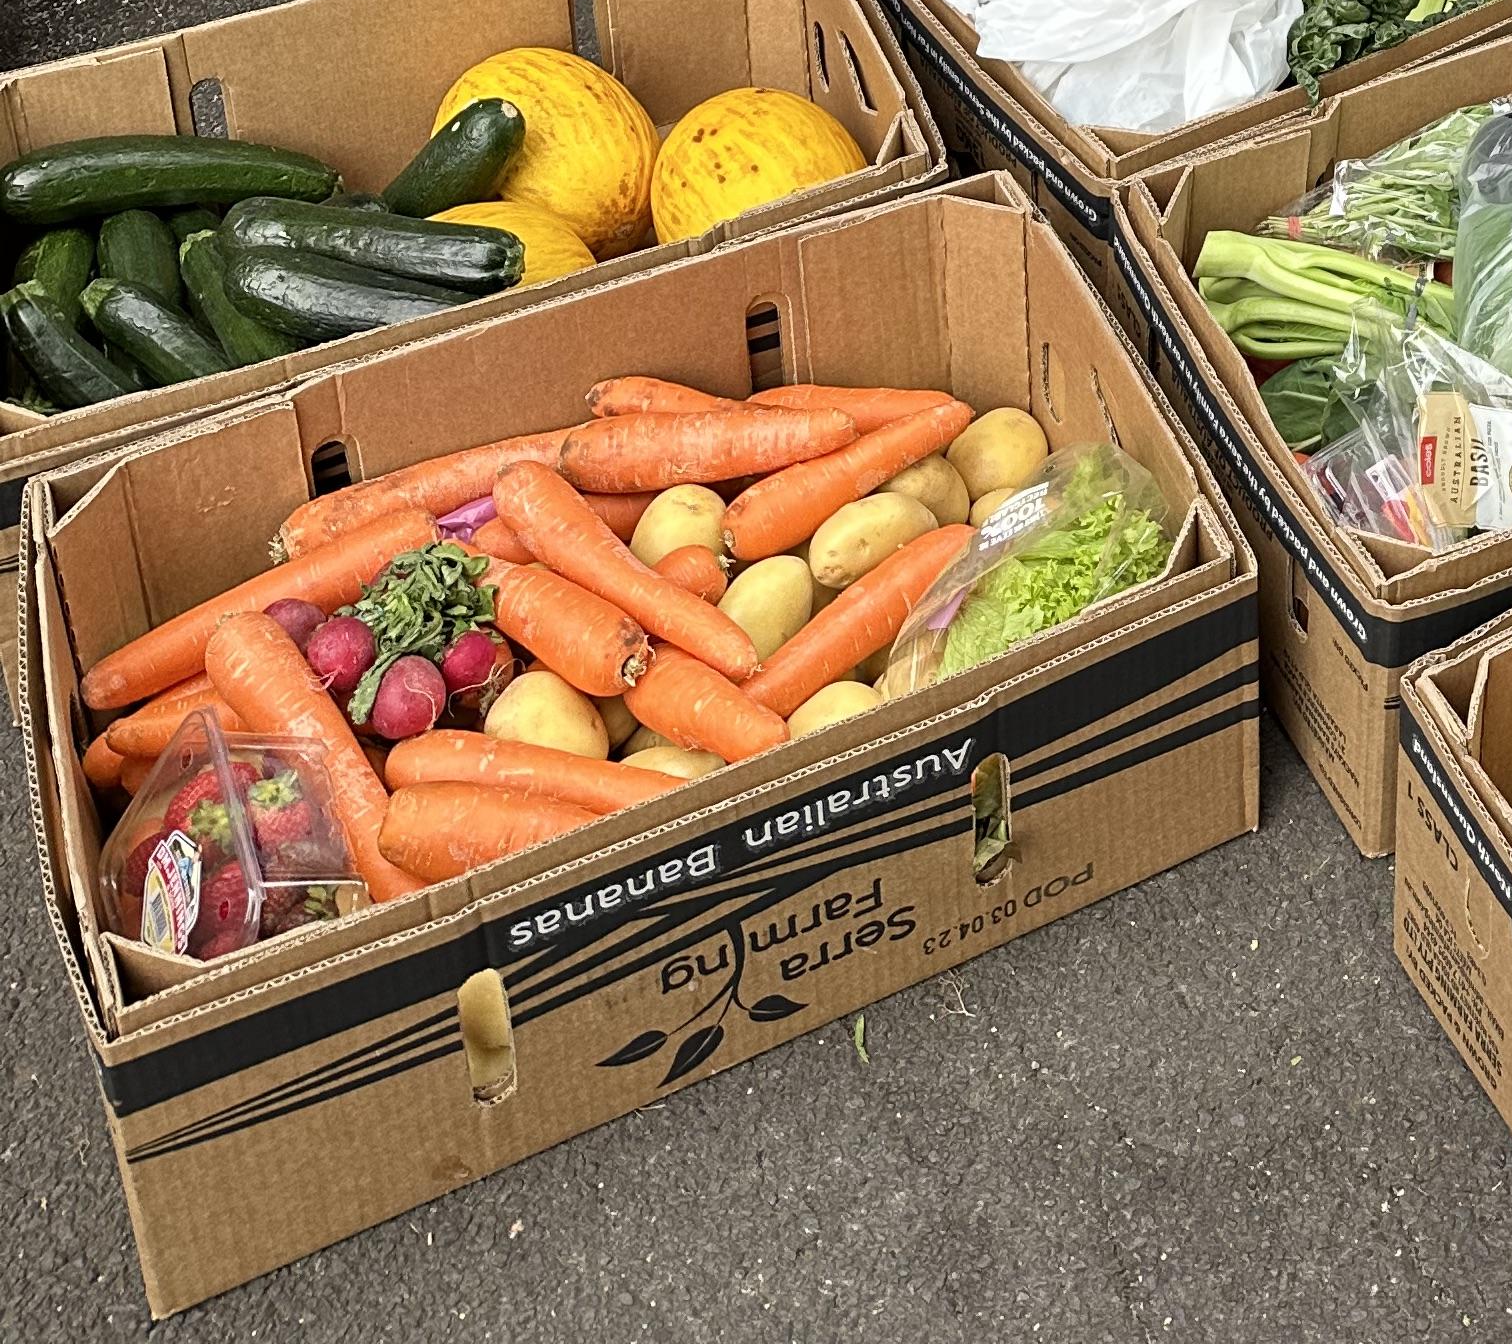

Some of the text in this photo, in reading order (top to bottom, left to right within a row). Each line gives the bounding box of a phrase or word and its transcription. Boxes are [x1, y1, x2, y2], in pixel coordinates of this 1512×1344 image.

[984, 107, 1000, 128] the
[1000, 123, 1013, 142] by
[1012, 134, 1045, 178] packed
[1045, 167, 1065, 189] and
[1064, 186, 1098, 224] Grown
[1113, 235, 1369, 643] Grown and packed by the Serra Family in Far North Queensland
[1425, 442, 1433, 478] coles
[1450, 416, 1462, 504] AUSTRALIAN
[1411, 734, 1476, 845] Queensland
[507, 737, 976, 954] Australian Bananas
[1418, 796, 1459, 872] CLASS
[1022, 861, 1096, 907] POD
[1477, 840, 1512, 900] North
[780, 903, 918, 984] Serra
[1403, 916, 1503, 1078] SERRA FARMING PTY LTD
[1419, 967, 1454, 1025] PACKED
[1462, 1031, 1498, 1091] GROWN
